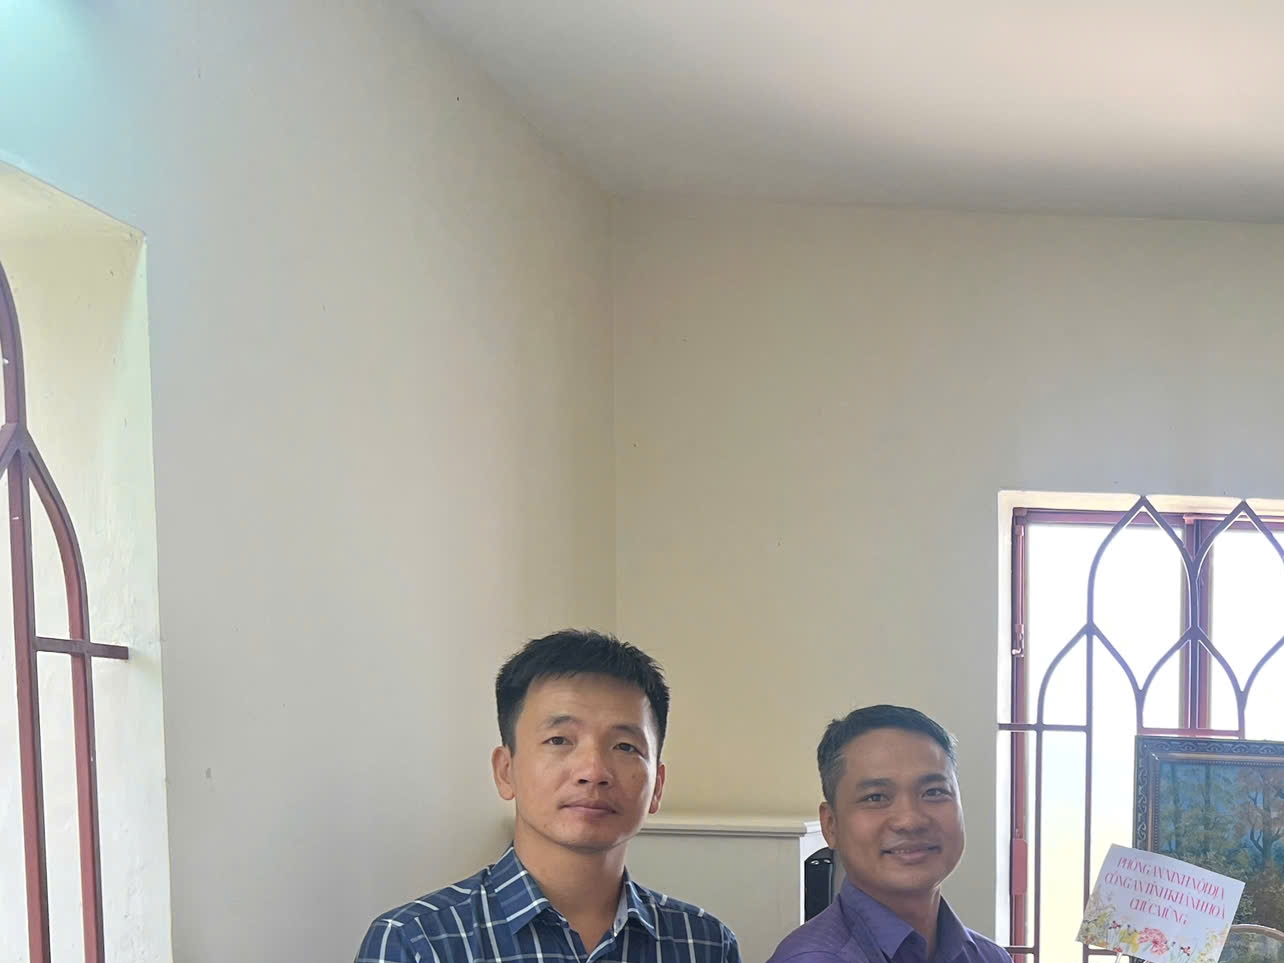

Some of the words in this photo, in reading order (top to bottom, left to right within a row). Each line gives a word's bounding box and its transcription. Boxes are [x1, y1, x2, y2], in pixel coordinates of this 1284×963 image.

[1104, 871, 1131, 889] CÔNG
[1132, 878, 1144, 893] AN
[1117, 856, 1152, 874] PHÒNG
[1152, 864, 1163, 879] AN
[1165, 868, 1191, 888] NINH
[1129, 897, 1156, 914] CHÚC
